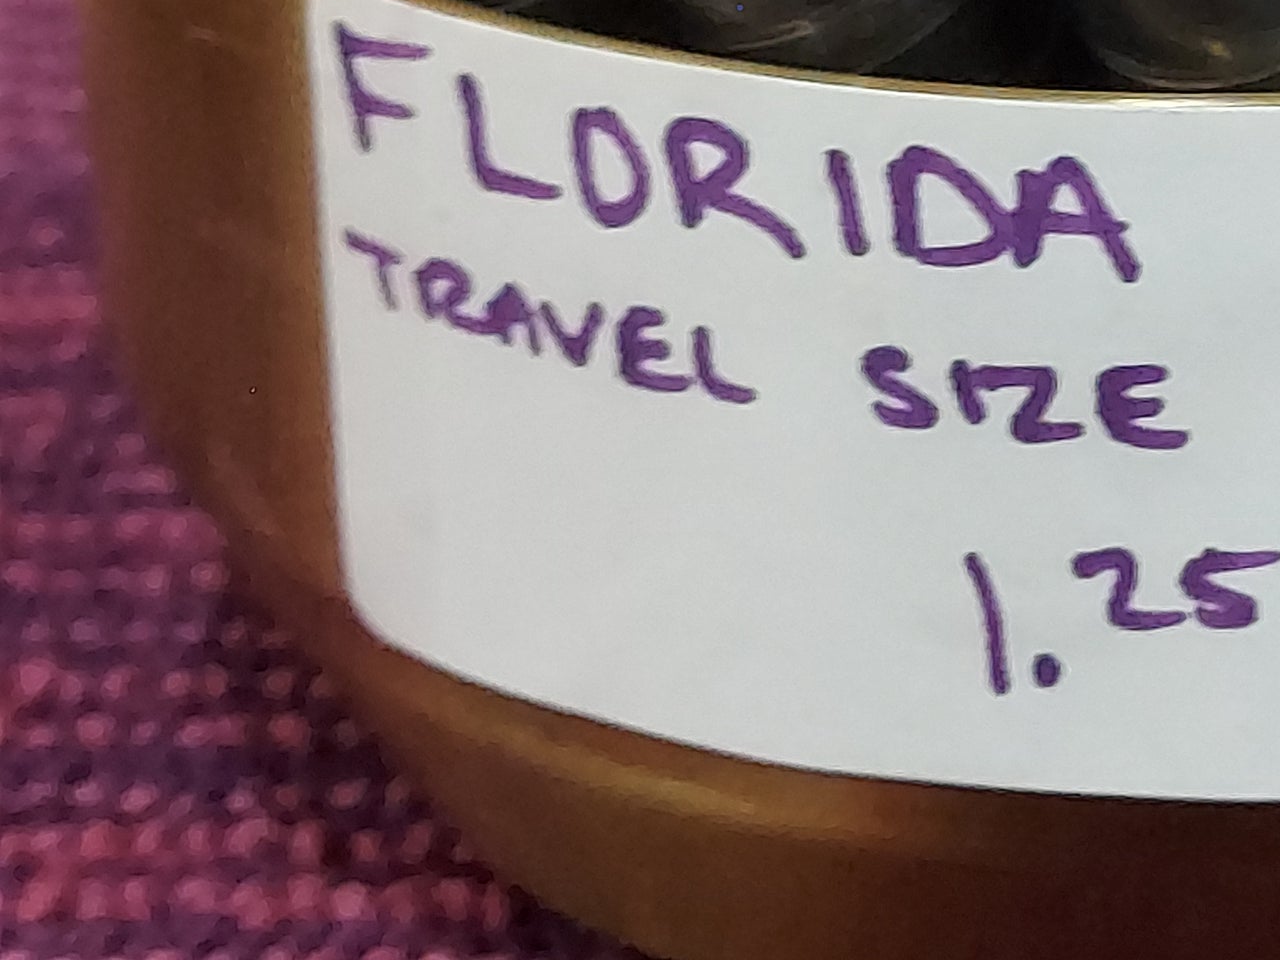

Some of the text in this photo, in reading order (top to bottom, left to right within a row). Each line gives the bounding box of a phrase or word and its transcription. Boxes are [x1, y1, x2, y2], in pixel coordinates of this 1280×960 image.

[335, 22, 1142, 284] FLORIDA
[343, 228, 757, 405] TRAVEL
[861, 344, 1191, 451] SIZE
